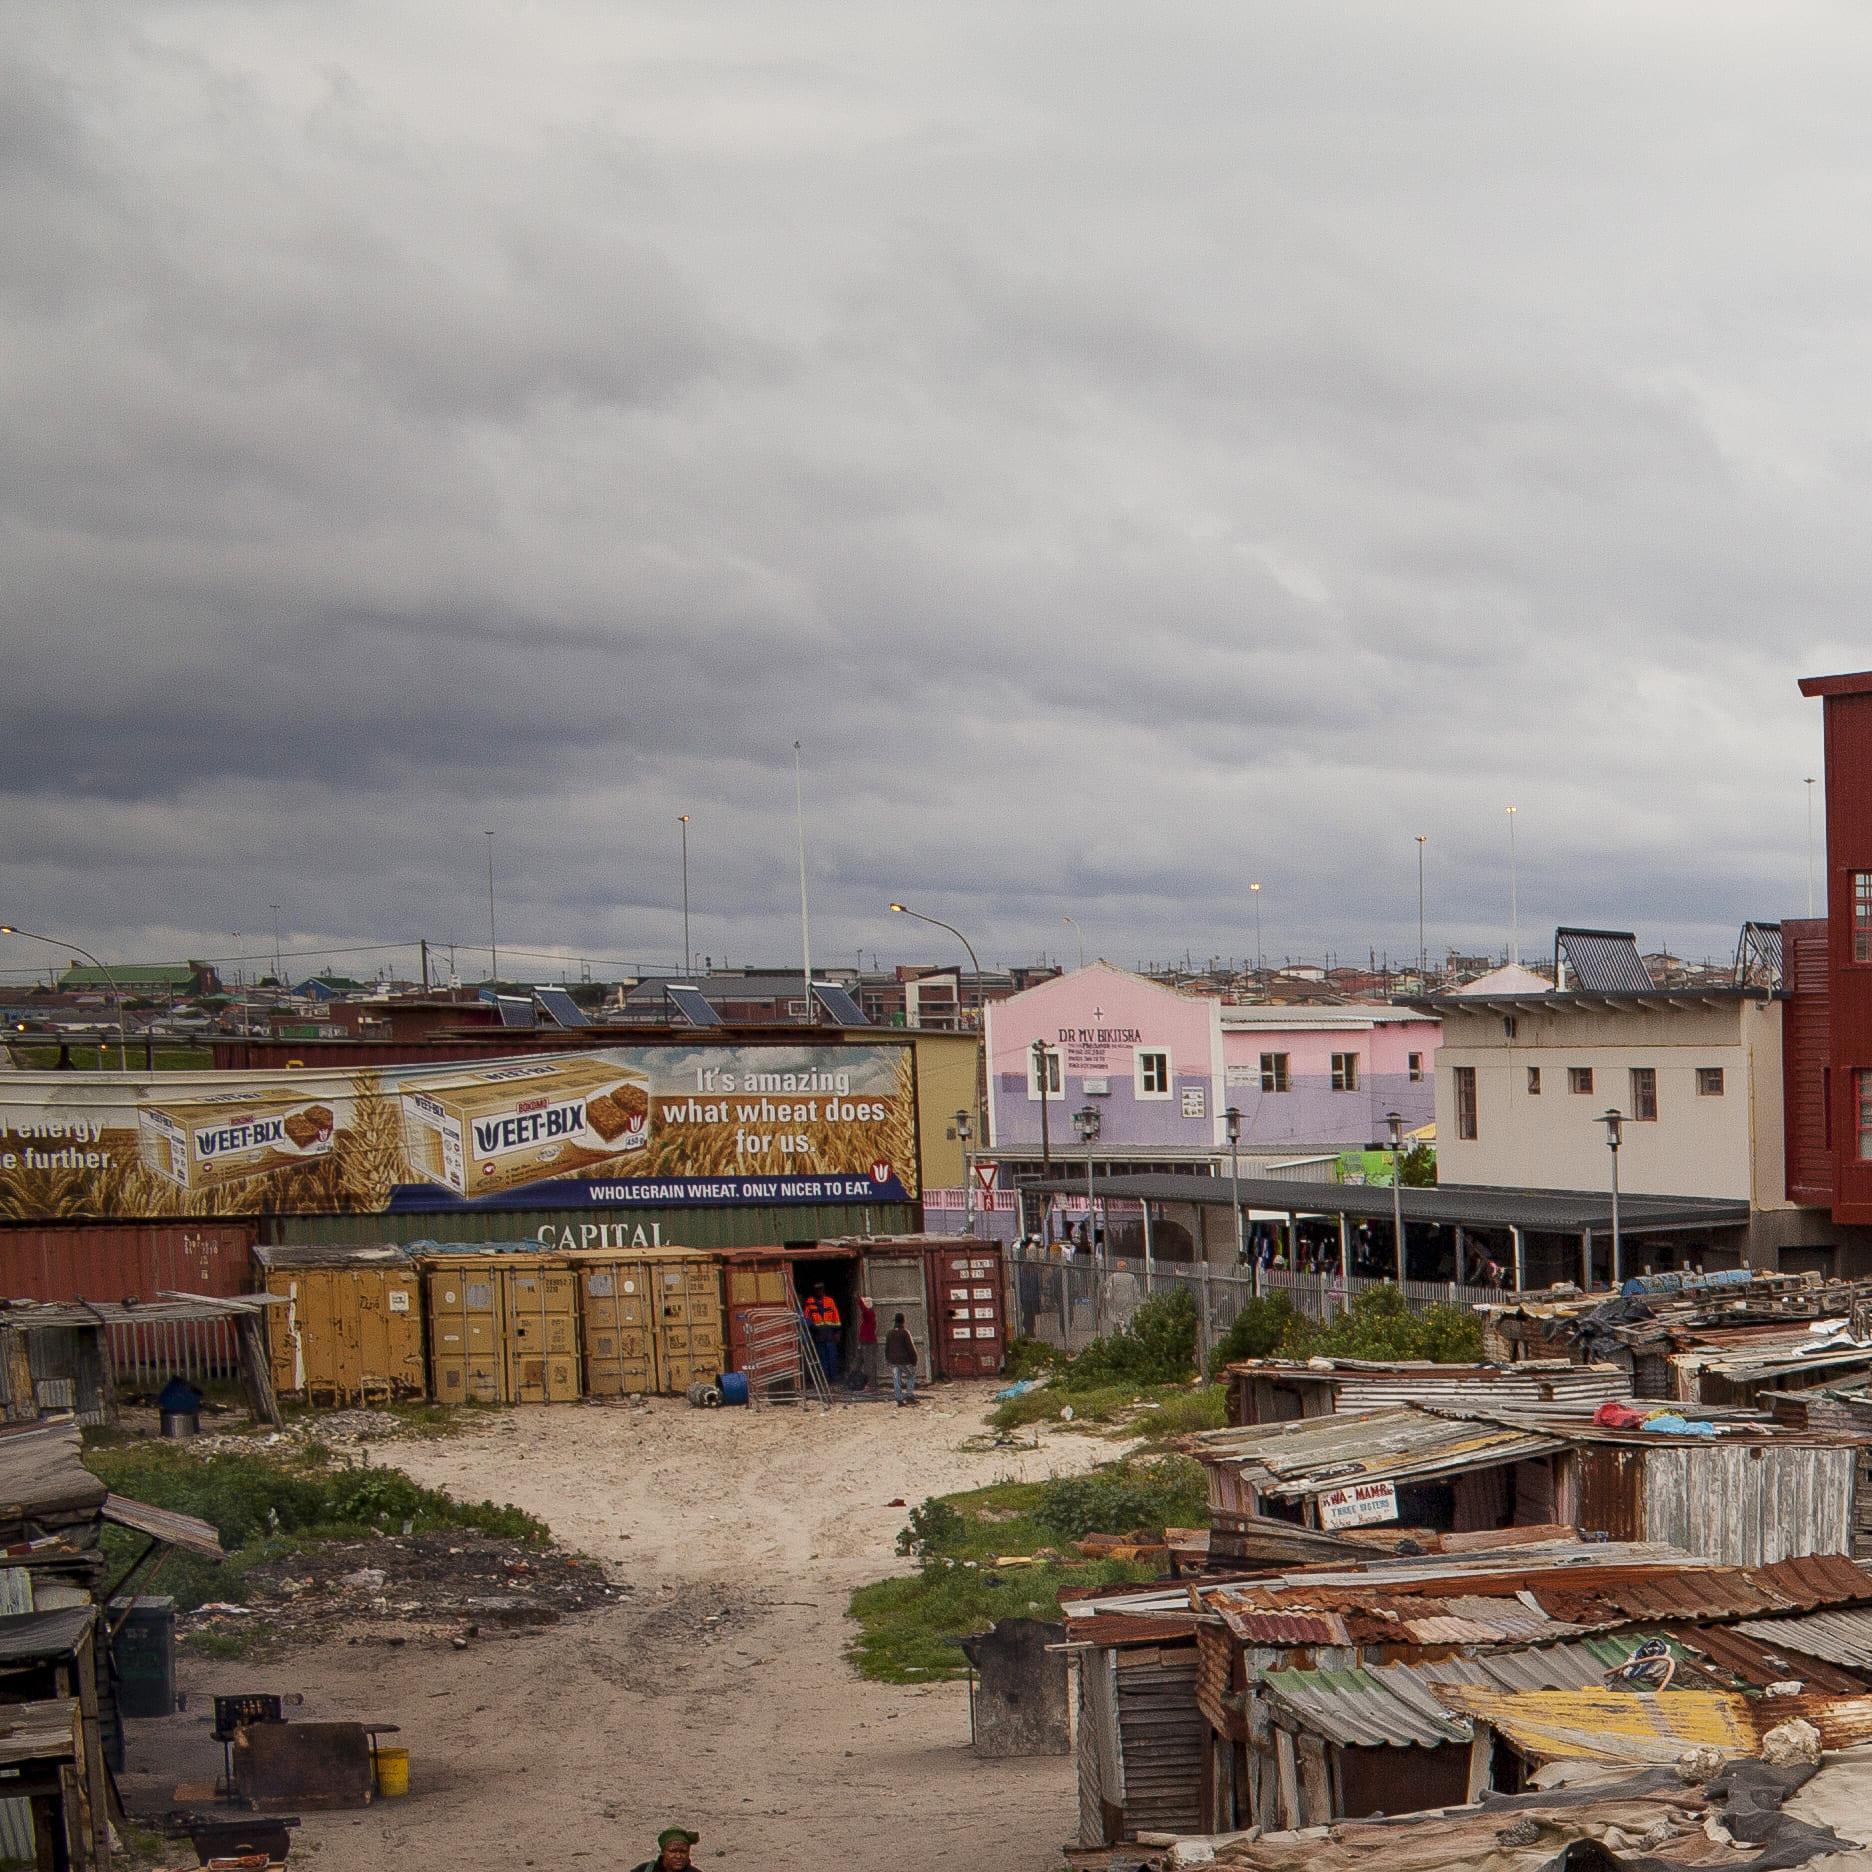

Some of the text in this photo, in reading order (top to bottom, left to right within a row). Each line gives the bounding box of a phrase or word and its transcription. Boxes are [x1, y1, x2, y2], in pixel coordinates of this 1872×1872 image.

[1059, 1029, 1076, 1042] DR
[696, 1067, 850, 1095] It's amazing
[663, 1098, 885, 1123] what wheat does
[18, 1119, 104, 1143] energy
[736, 1130, 817, 1153] for us.
[24, 1147, 118, 1170] further.
[590, 1181, 873, 1200] WHOLEGRAIN WHEAT. ONLY NICER TO EAT.
[537, 1223, 671, 1250] CAPITAL
